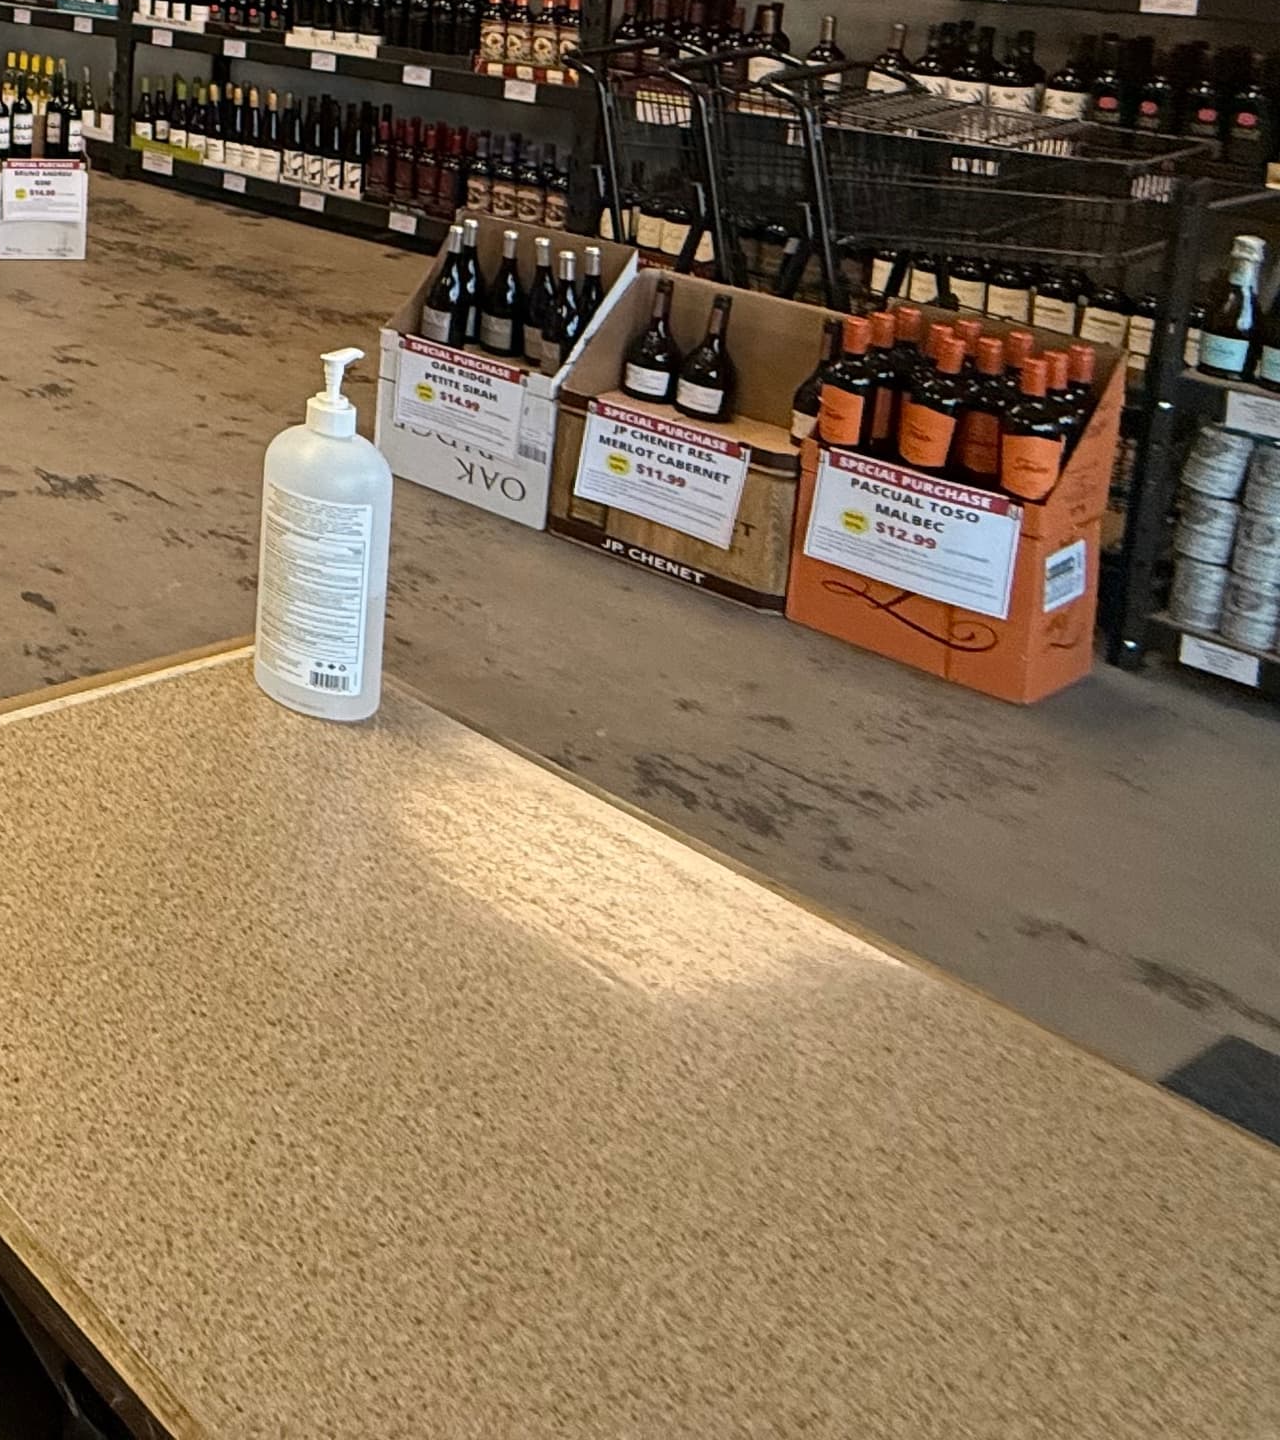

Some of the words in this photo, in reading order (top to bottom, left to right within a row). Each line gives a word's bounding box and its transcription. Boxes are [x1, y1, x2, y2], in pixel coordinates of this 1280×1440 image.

[411, 341, 452, 361] SPECIAL
[453, 354, 511, 379] PURCHASE
[431, 361, 455, 373] OAK
[458, 369, 492, 386] RIDGE
[425, 372, 460, 390] PETITE
[462, 384, 498, 402] SIRAH
[439, 391, 480, 412] $14.99
[604, 406, 655, 430] SPECIAL
[657, 424, 729, 452] PURCHASE
[613, 425, 628, 435] JP
[631, 430, 685, 454] CHENET
[687, 447, 717, 464] RES.
[599, 434, 655, 460] MERLOT
[657, 454, 731, 485] CABERNET
[635, 463, 687, 488] $11.99
[455, 456, 527, 501] OAK
[840, 456, 899, 484] SPECIAL
[901, 475, 992, 509] PURCHASE
[851, 477, 924, 509] PASCUAL
[928, 501, 980, 523] TOSO
[875, 503, 945, 534] MALBEC
[875, 521, 937, 550] $12.99
[628, 549, 705, 584] CHENET
